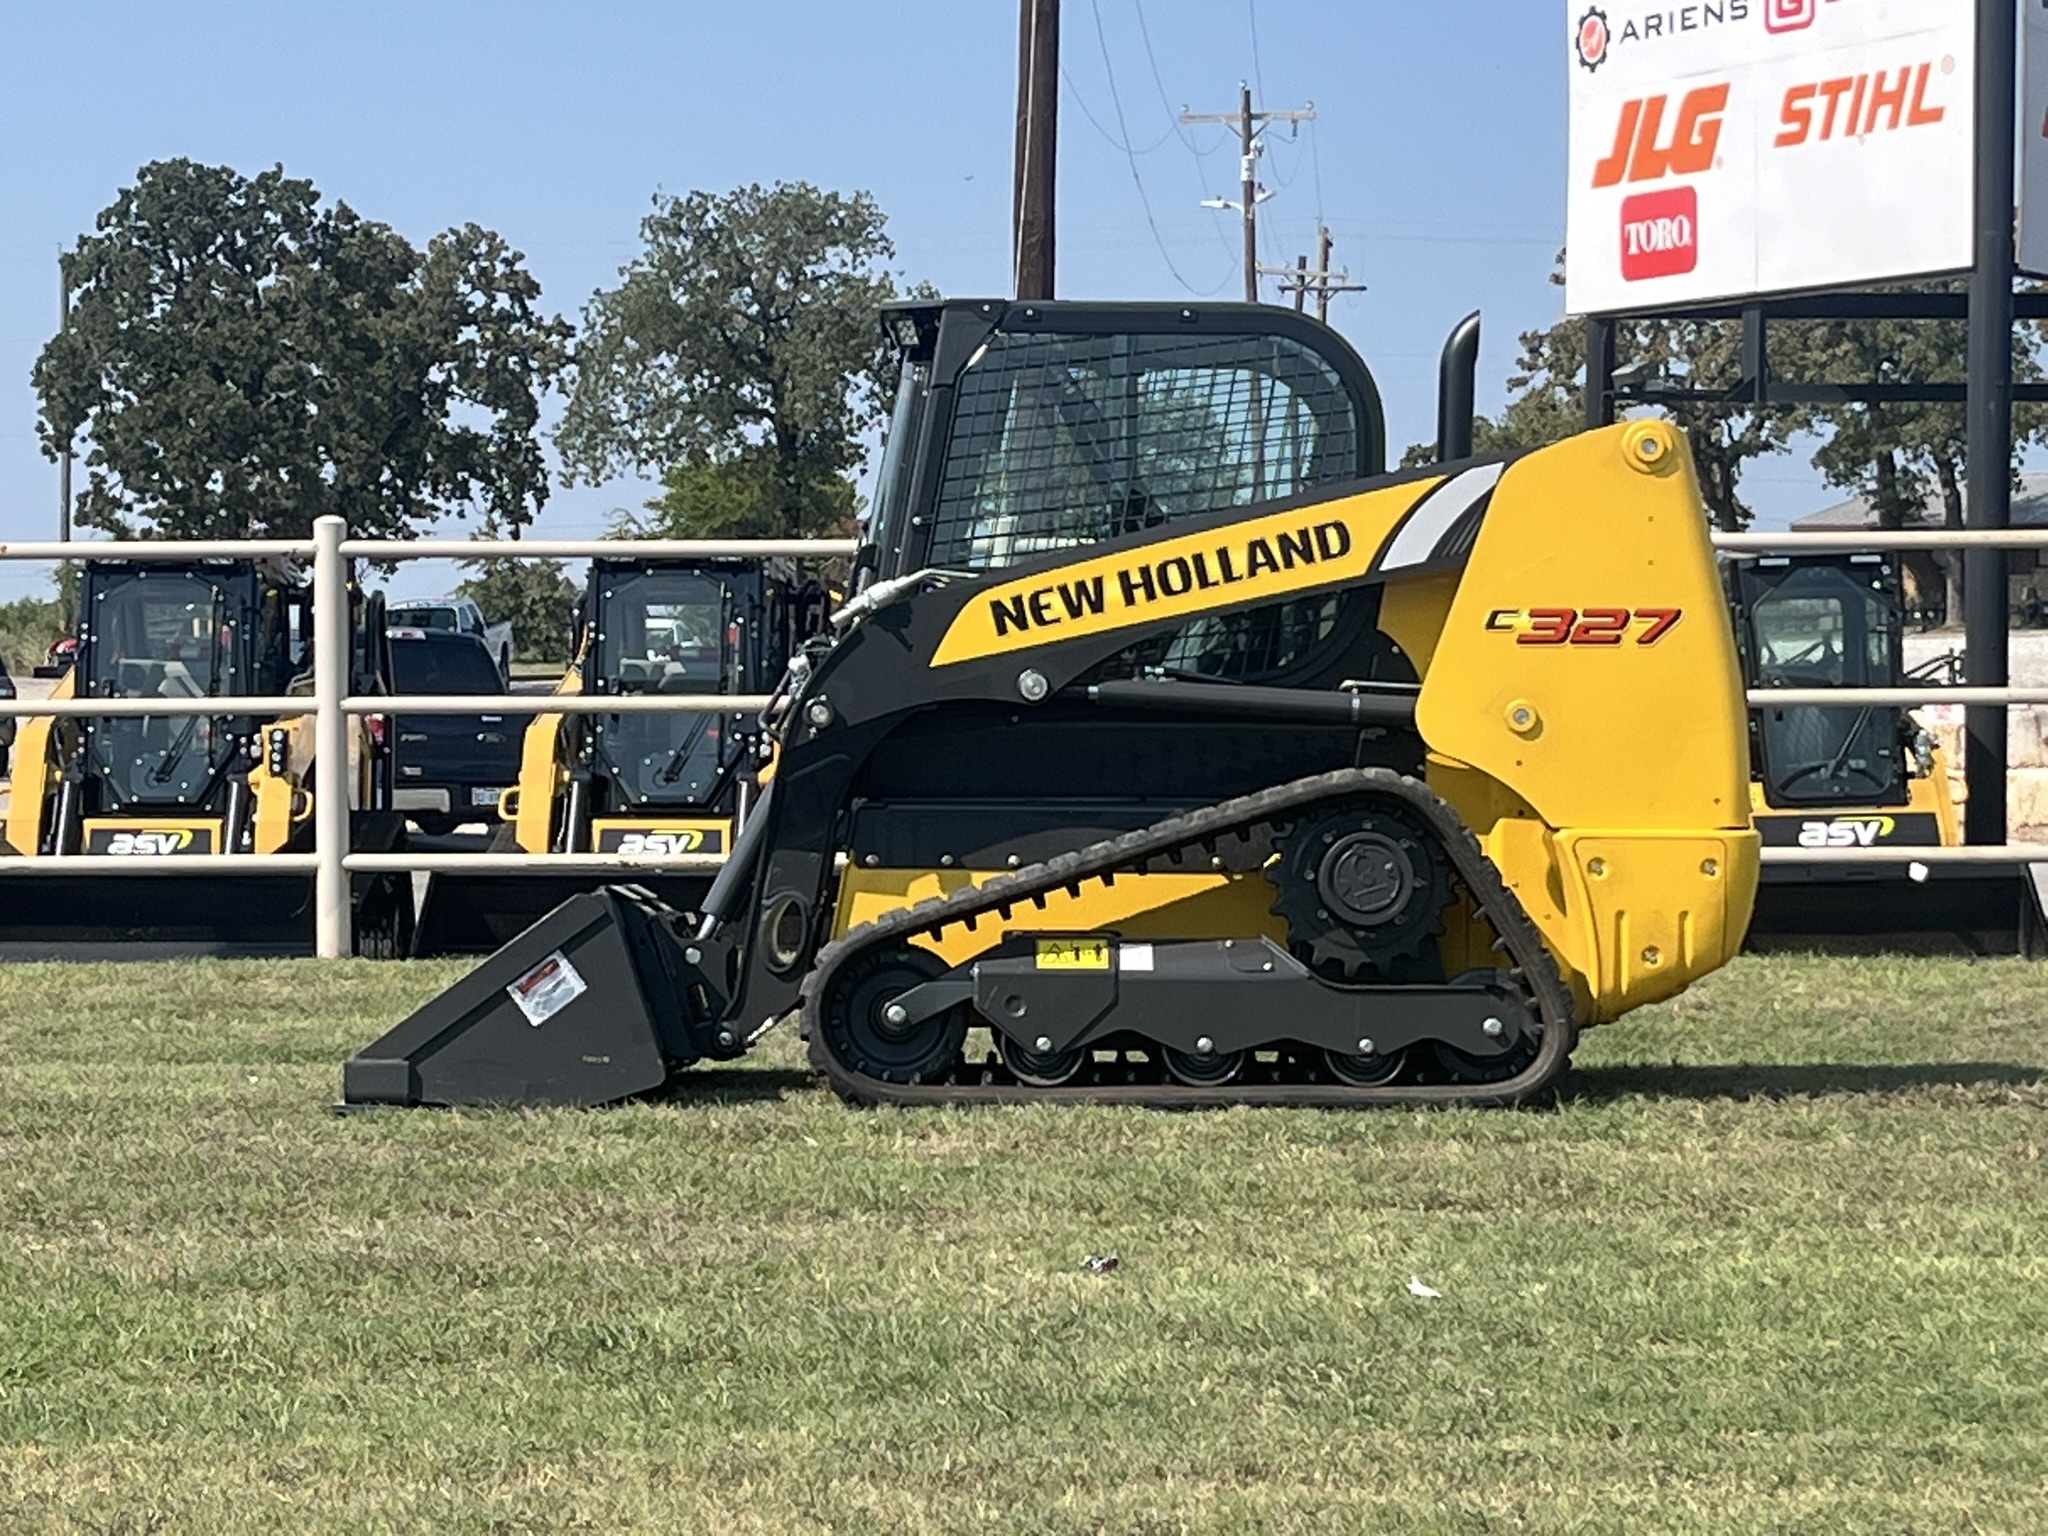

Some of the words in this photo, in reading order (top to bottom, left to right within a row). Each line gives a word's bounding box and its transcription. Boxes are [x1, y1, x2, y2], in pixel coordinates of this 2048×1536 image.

[1620, 0, 1749, 45] ARIENS
[1591, 82, 1731, 189] JLG
[1773, 62, 1946, 148] STIHL
[1625, 213, 1692, 255] TORO
[990, 576, 1105, 636] NEW
[1120, 520, 1352, 607] HOLLAND
